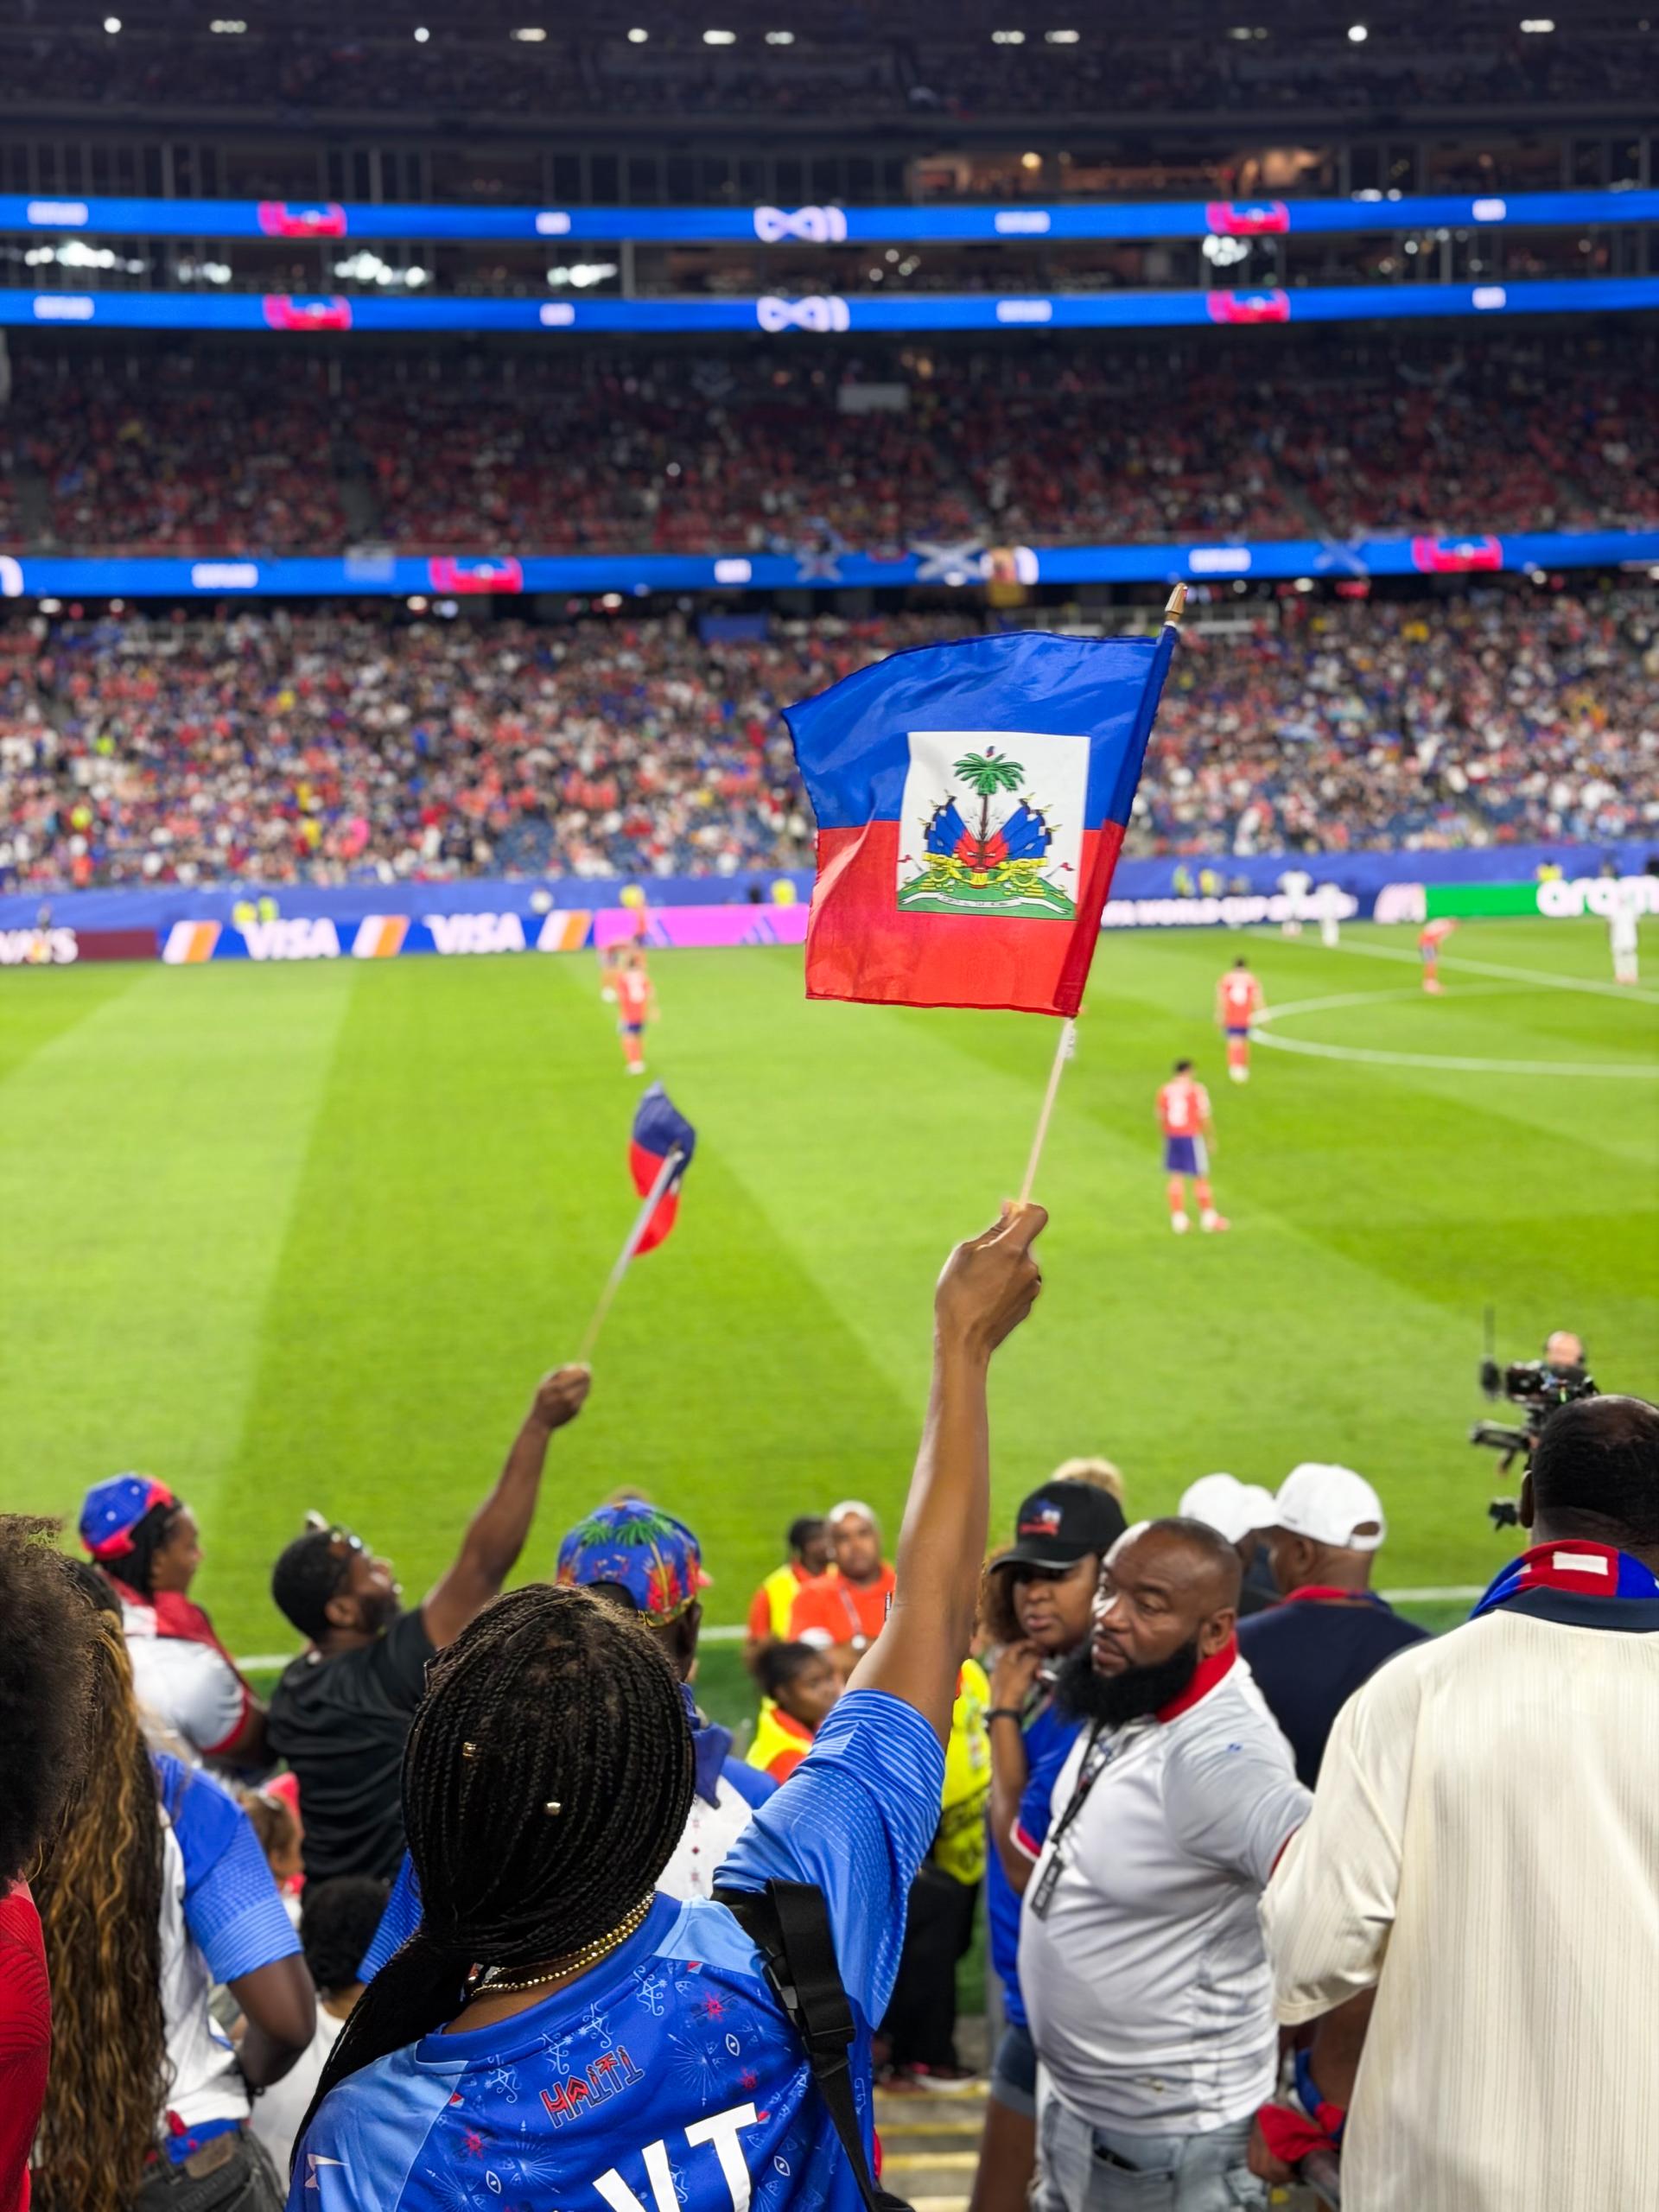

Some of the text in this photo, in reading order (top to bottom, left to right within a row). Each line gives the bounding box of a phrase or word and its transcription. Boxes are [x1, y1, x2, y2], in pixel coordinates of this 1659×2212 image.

[236, 917, 340, 961] VISA
[422, 912, 525, 955] VISA
[539, 2044, 645, 2129] HAITI
